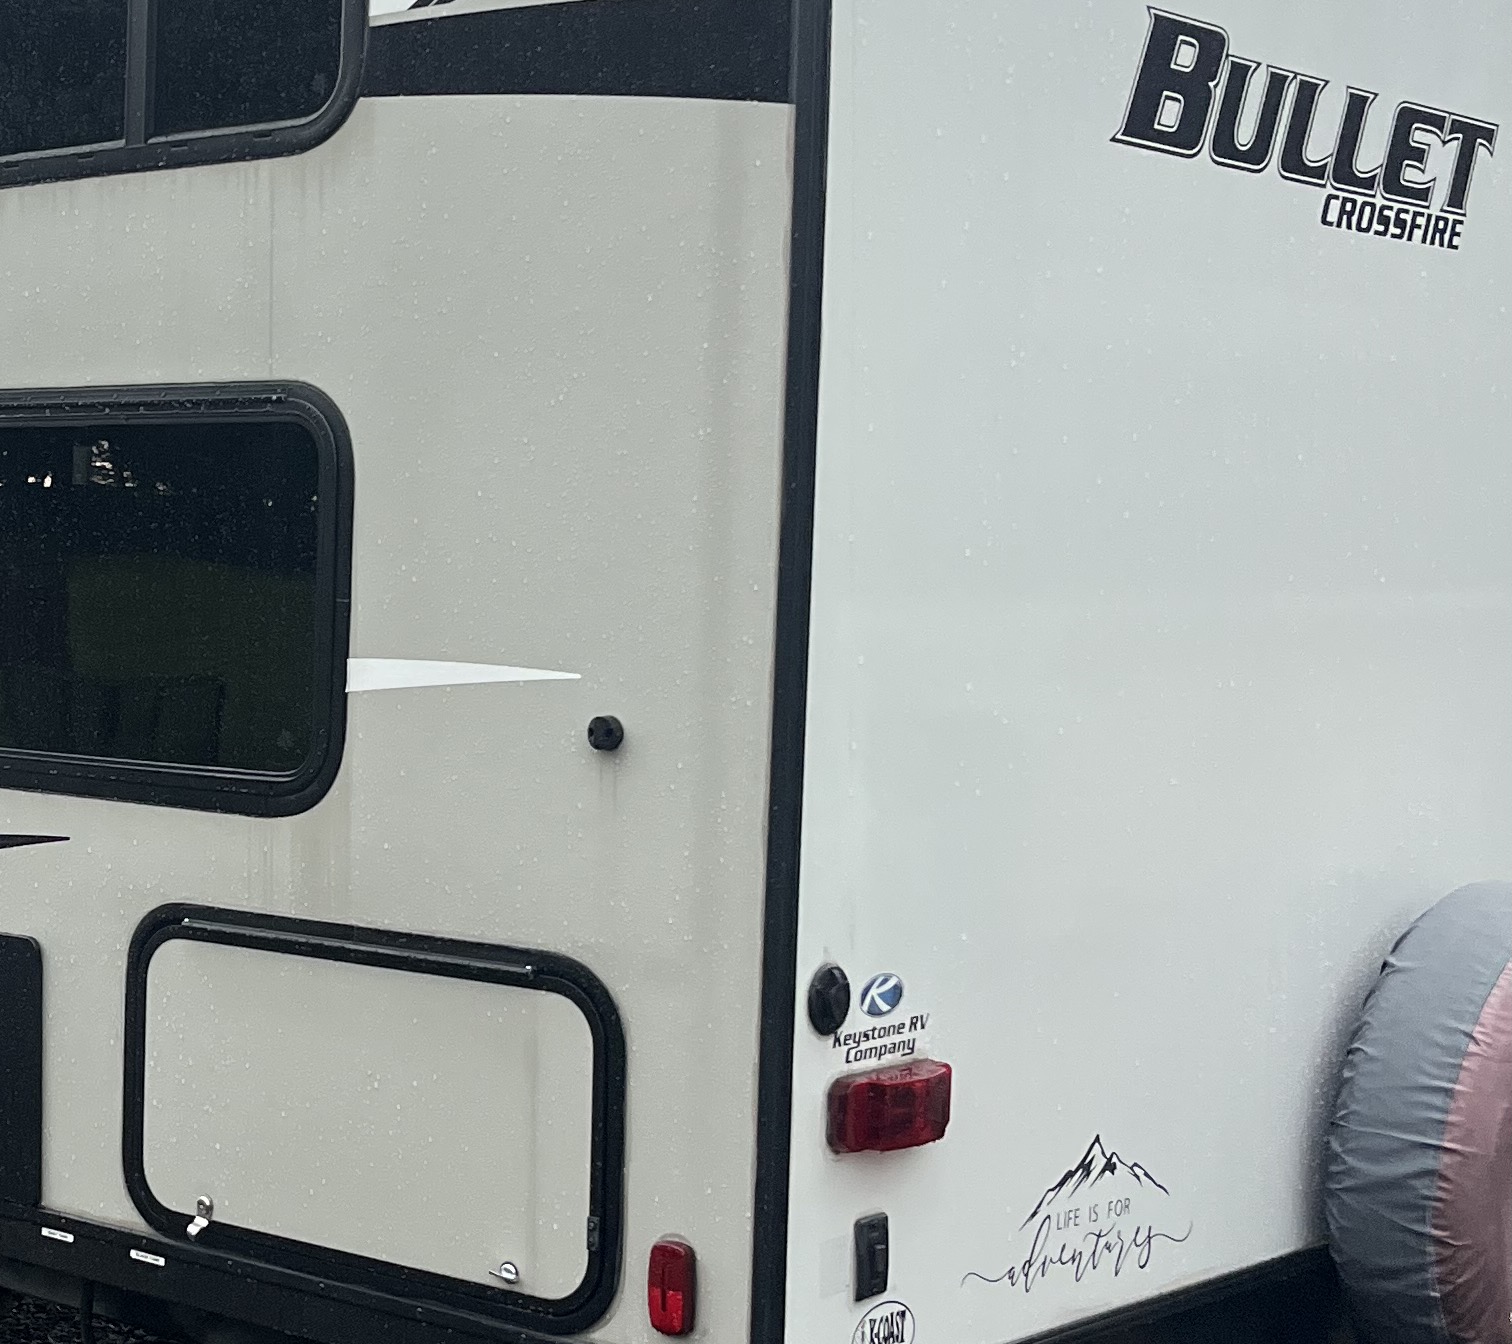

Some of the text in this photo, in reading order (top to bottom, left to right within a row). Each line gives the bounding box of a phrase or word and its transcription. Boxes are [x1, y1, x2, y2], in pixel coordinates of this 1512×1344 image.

[1109, 5, 1500, 216] BULLET
[1320, 192, 1466, 250] CROSSFIRE
[832, 1012, 930, 1049] Keystone RV
[845, 1037, 917, 1064] Company
[1056, 1197, 1131, 1231] LIFE IS FOR
